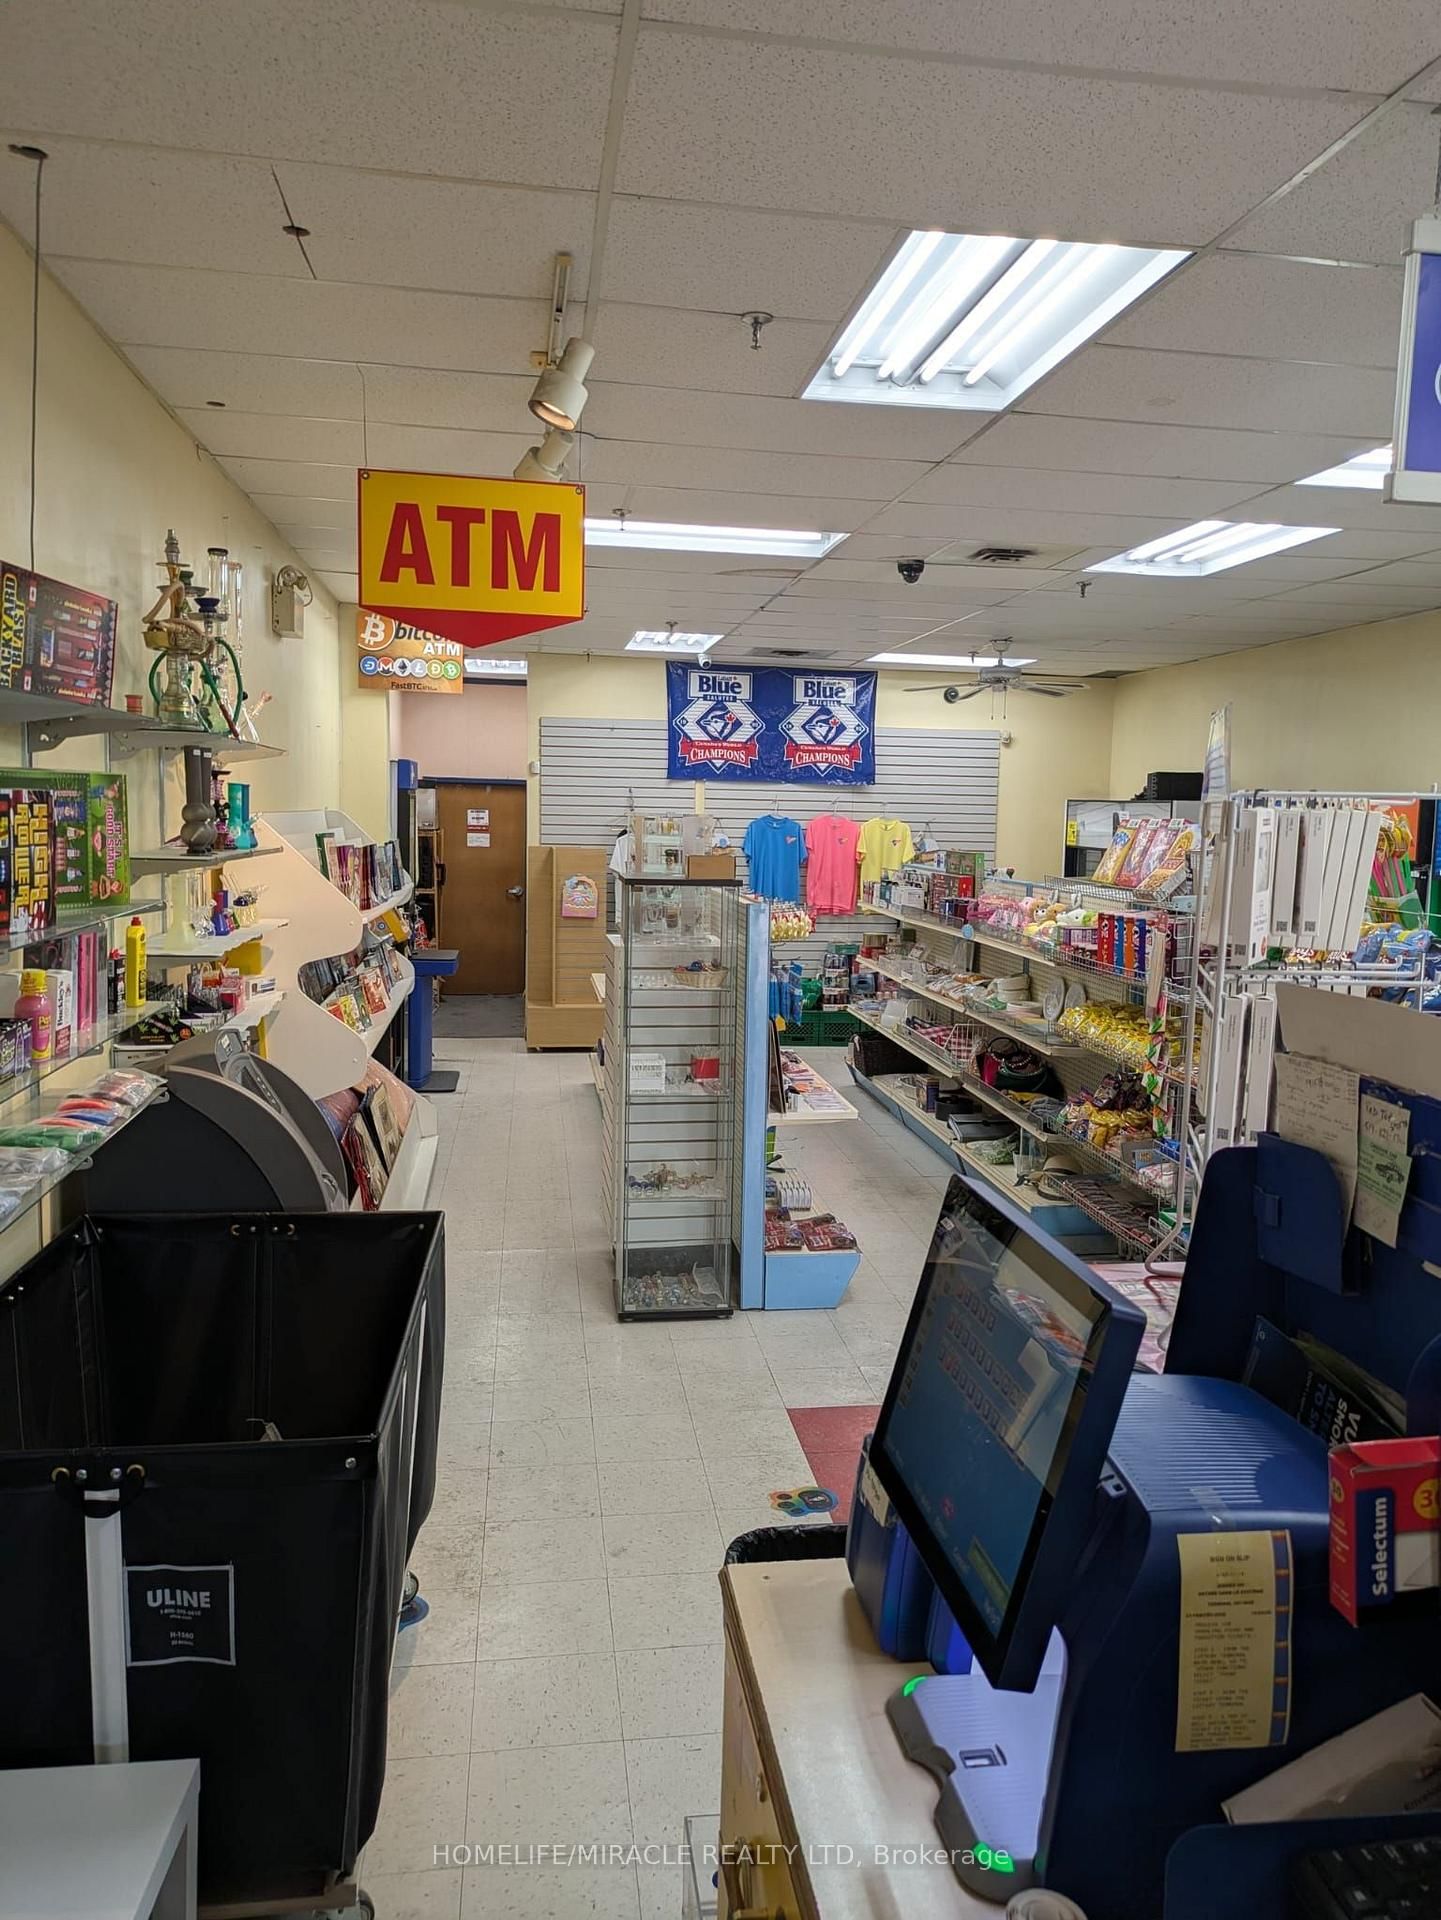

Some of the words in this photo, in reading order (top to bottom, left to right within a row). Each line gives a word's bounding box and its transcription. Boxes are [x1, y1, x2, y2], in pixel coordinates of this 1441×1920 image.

[379, 502, 561, 593] ATM
[0, 580, 16, 687] BACKYARD
[11, 602, 25, 666] BLAST
[395, 621, 453, 642] bitc
[423, 642, 460, 656] ATM
[698, 675, 742, 695] Blue
[803, 680, 846, 699] Blue
[690, 748, 746, 763] CHAMPIONS
[795, 752, 850, 766] CHAMPIONS
[106, 805, 115, 836] GOOD
[1371, 1496, 1388, 1596] Selectum
[146, 1588, 211, 1608] ULINE
